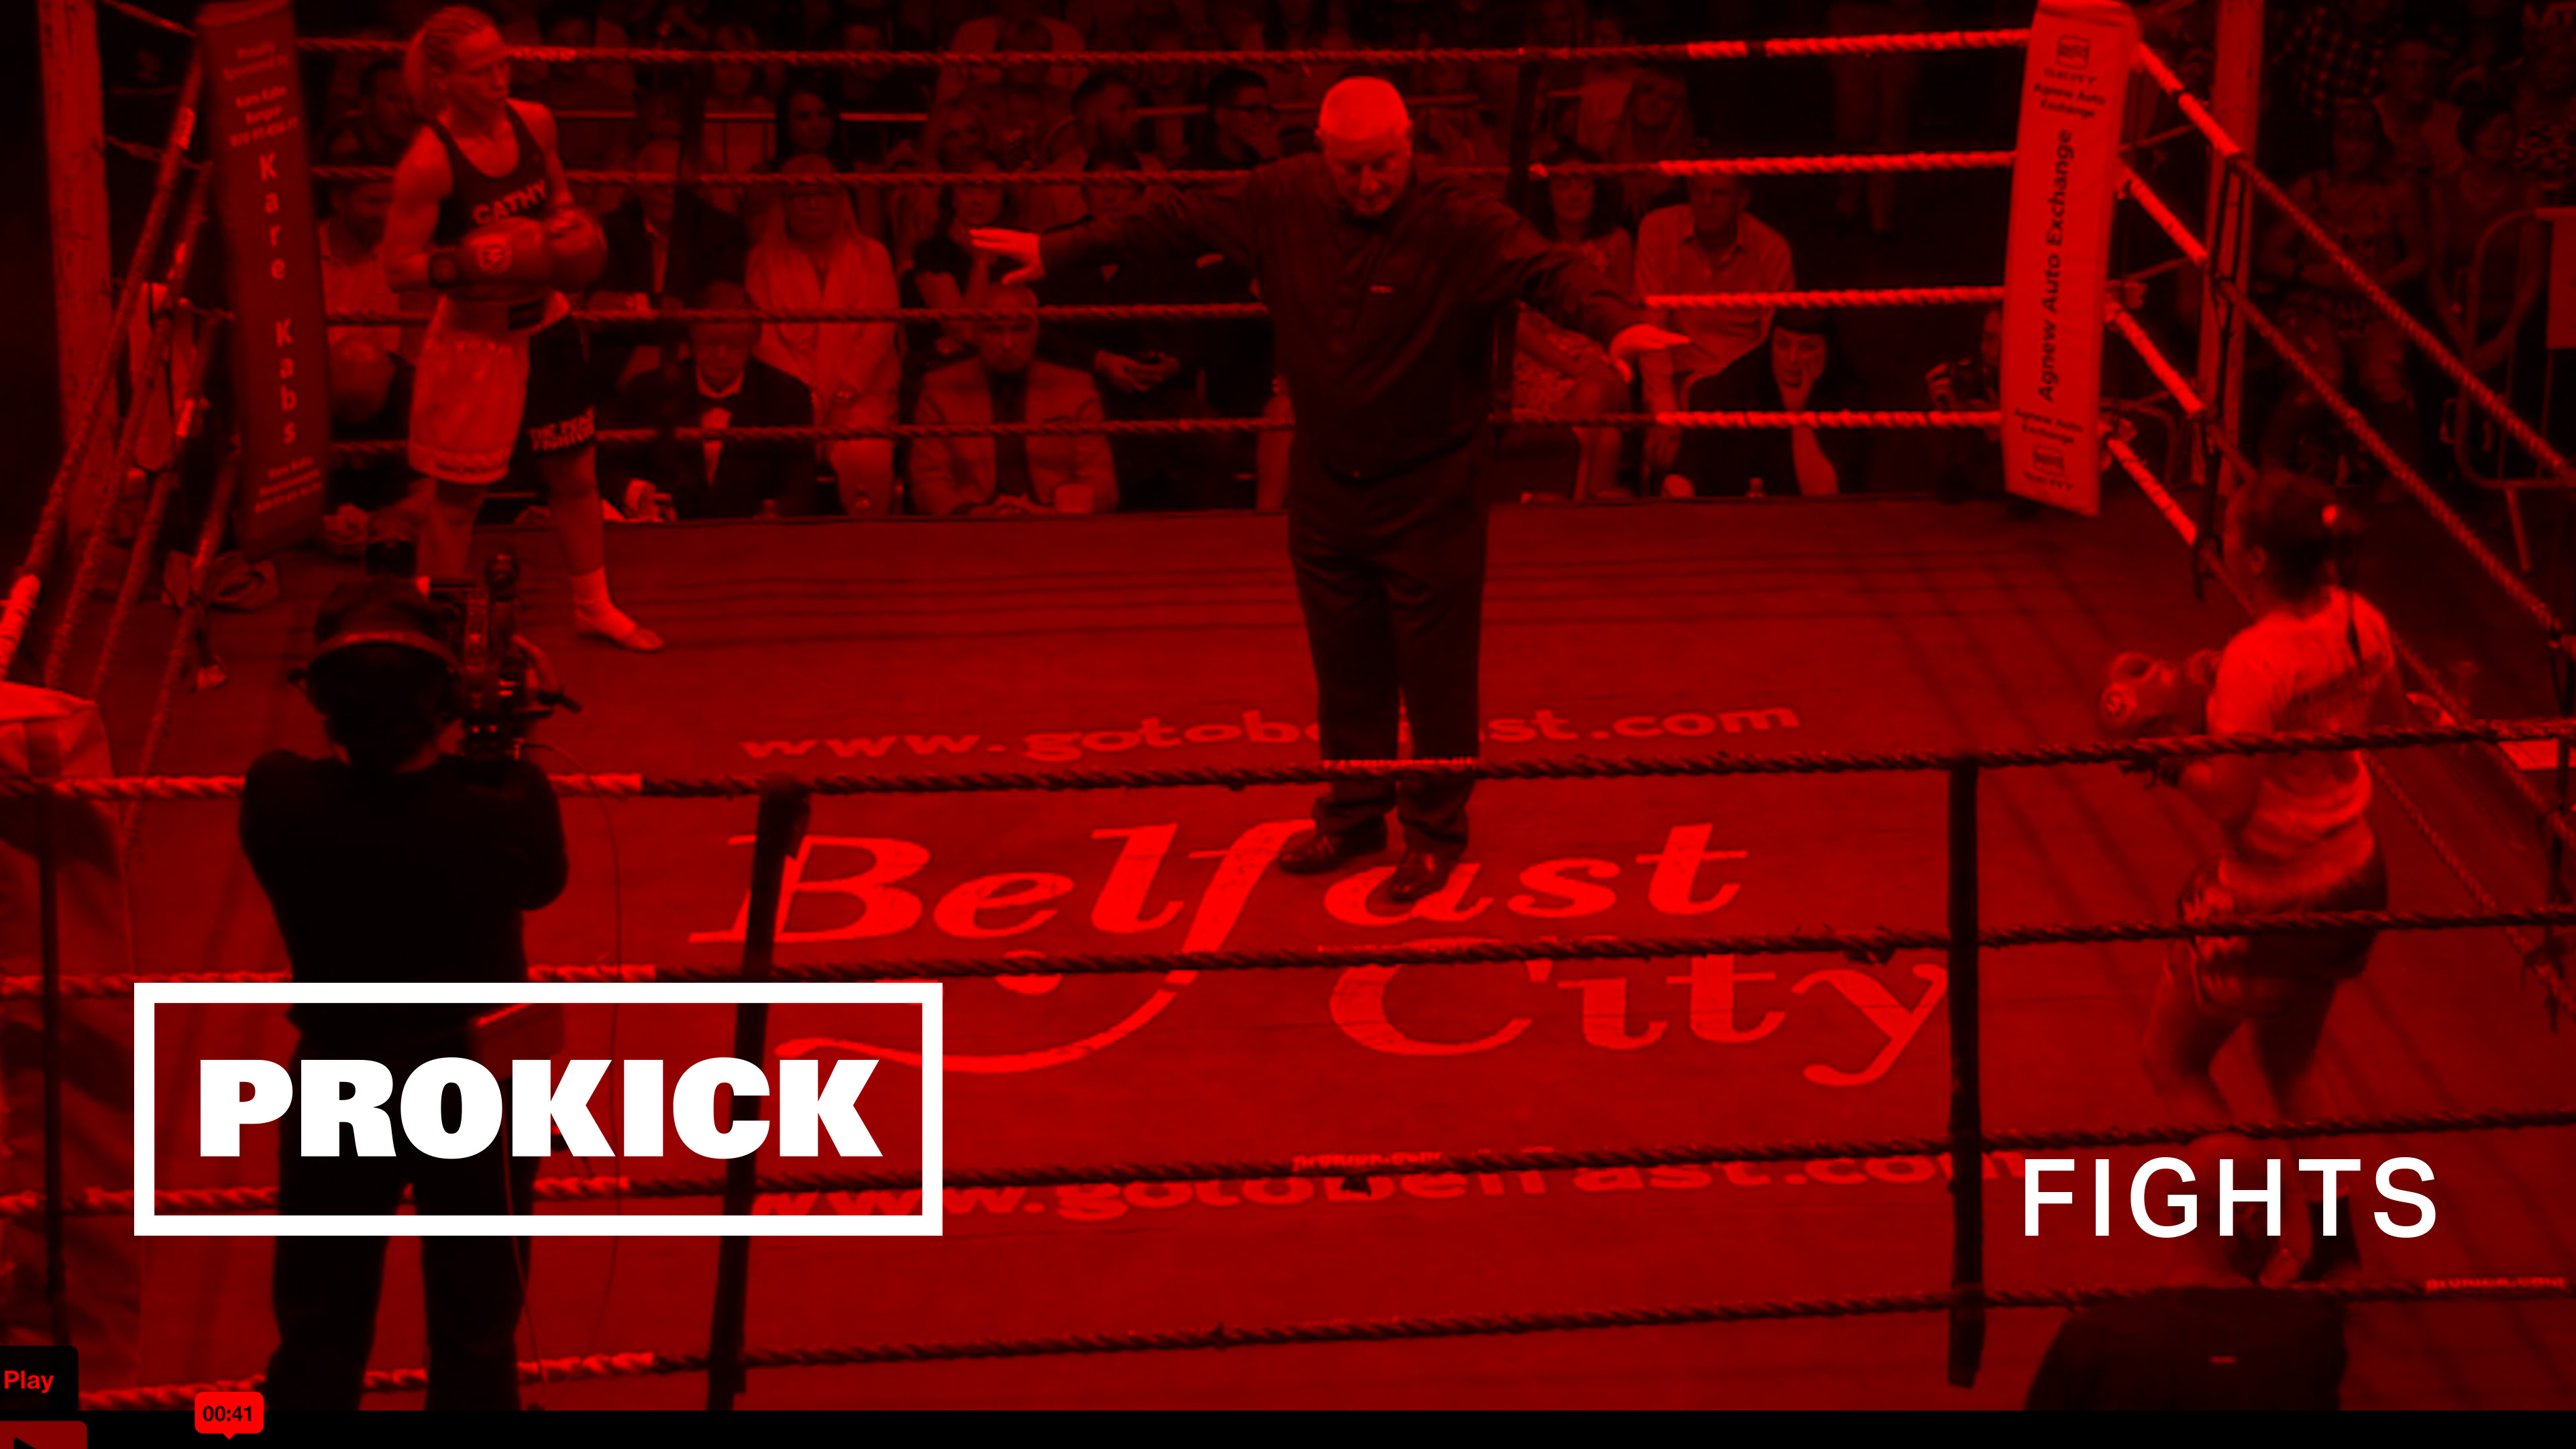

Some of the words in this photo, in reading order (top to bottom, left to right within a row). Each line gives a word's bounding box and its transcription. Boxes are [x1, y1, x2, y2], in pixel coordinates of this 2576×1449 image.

[236, 95, 260, 109] Kare
[262, 85, 287, 100] Kabs
[246, 105, 282, 125] Bangor
[2034, 83, 2075, 99] Agnew
[2077, 91, 2106, 105] Auto
[2041, 100, 2095, 119] Exchange
[472, 178, 547, 225] CATHY
[2047, 129, 2075, 246] Exchange
[2042, 254, 2061, 312] Auto
[2038, 319, 2058, 402] Agnew
[689, 822, 1748, 1073] Belfast
[1328, 936, 1948, 1086] City
